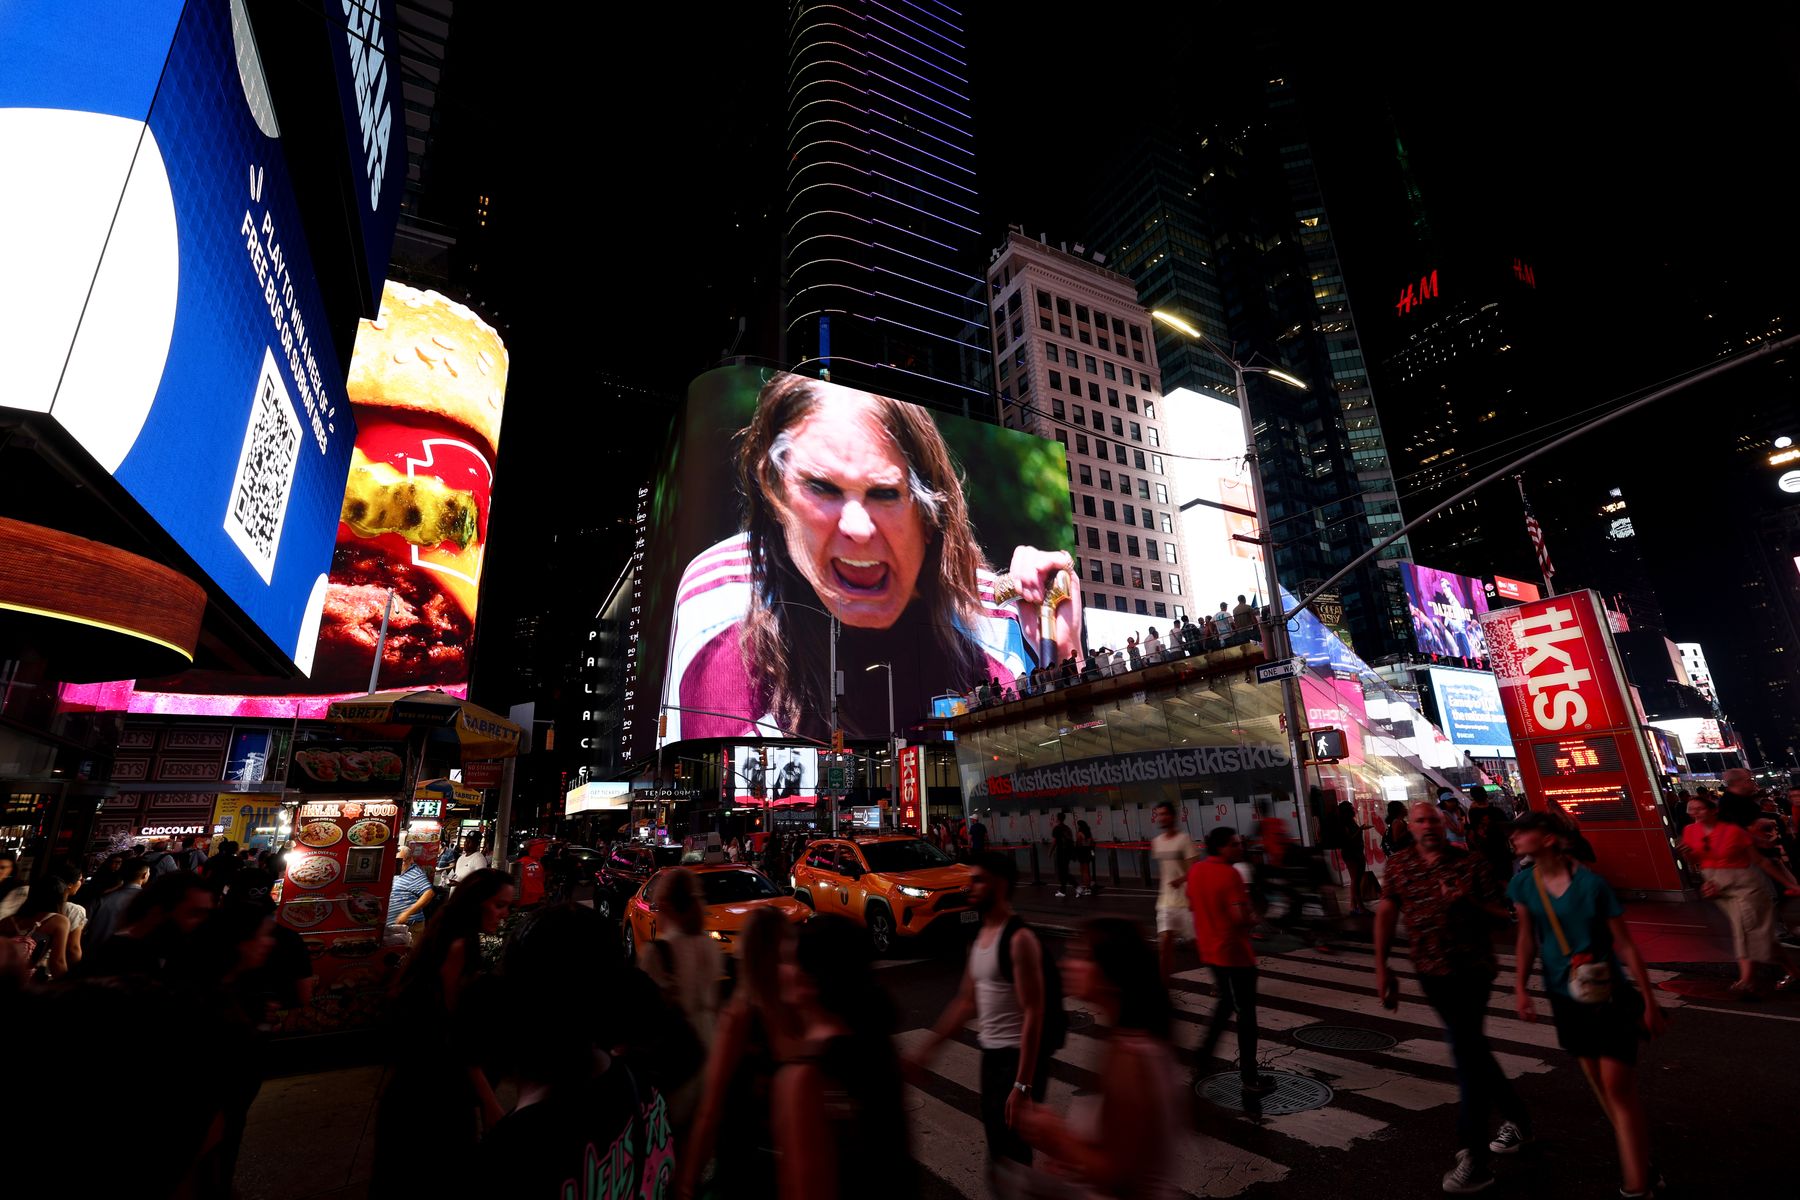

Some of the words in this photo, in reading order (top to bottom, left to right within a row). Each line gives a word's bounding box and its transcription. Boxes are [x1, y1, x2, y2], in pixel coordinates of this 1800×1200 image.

[341, 0, 382, 212] MENTS
[1395, 269, 1438, 317] H&M
[262, 209, 286, 280] PLAY
[282, 269, 294, 309] TO
[291, 299, 305, 345] WIN
[301, 337, 309, 361] A
[306, 347, 323, 400] WEEK
[319, 389, 329, 414] OF
[241, 209, 269, 288] FREE
[265, 275, 284, 330] BUS
[281, 321, 293, 359] OR
[290, 348, 315, 418] SUBWAY
[311, 407, 328, 455] RIDES
[1263, 666, 1278, 677] ONE
[1284, 662, 1300, 673] WAY
[1512, 606, 1592, 731] tkts
[464, 714, 519, 739] SABRETT
[168, 733, 223, 746] HERSHEY'S
[162, 763, 218, 776] HERSHEY'S
[300, 804, 341, 817] HALAL
[364, 804, 398, 817] FOOD
[1215, 804, 1227, 816] 10
[141, 826, 204, 835] CHOCOLATE
[361, 858, 369, 869] B
